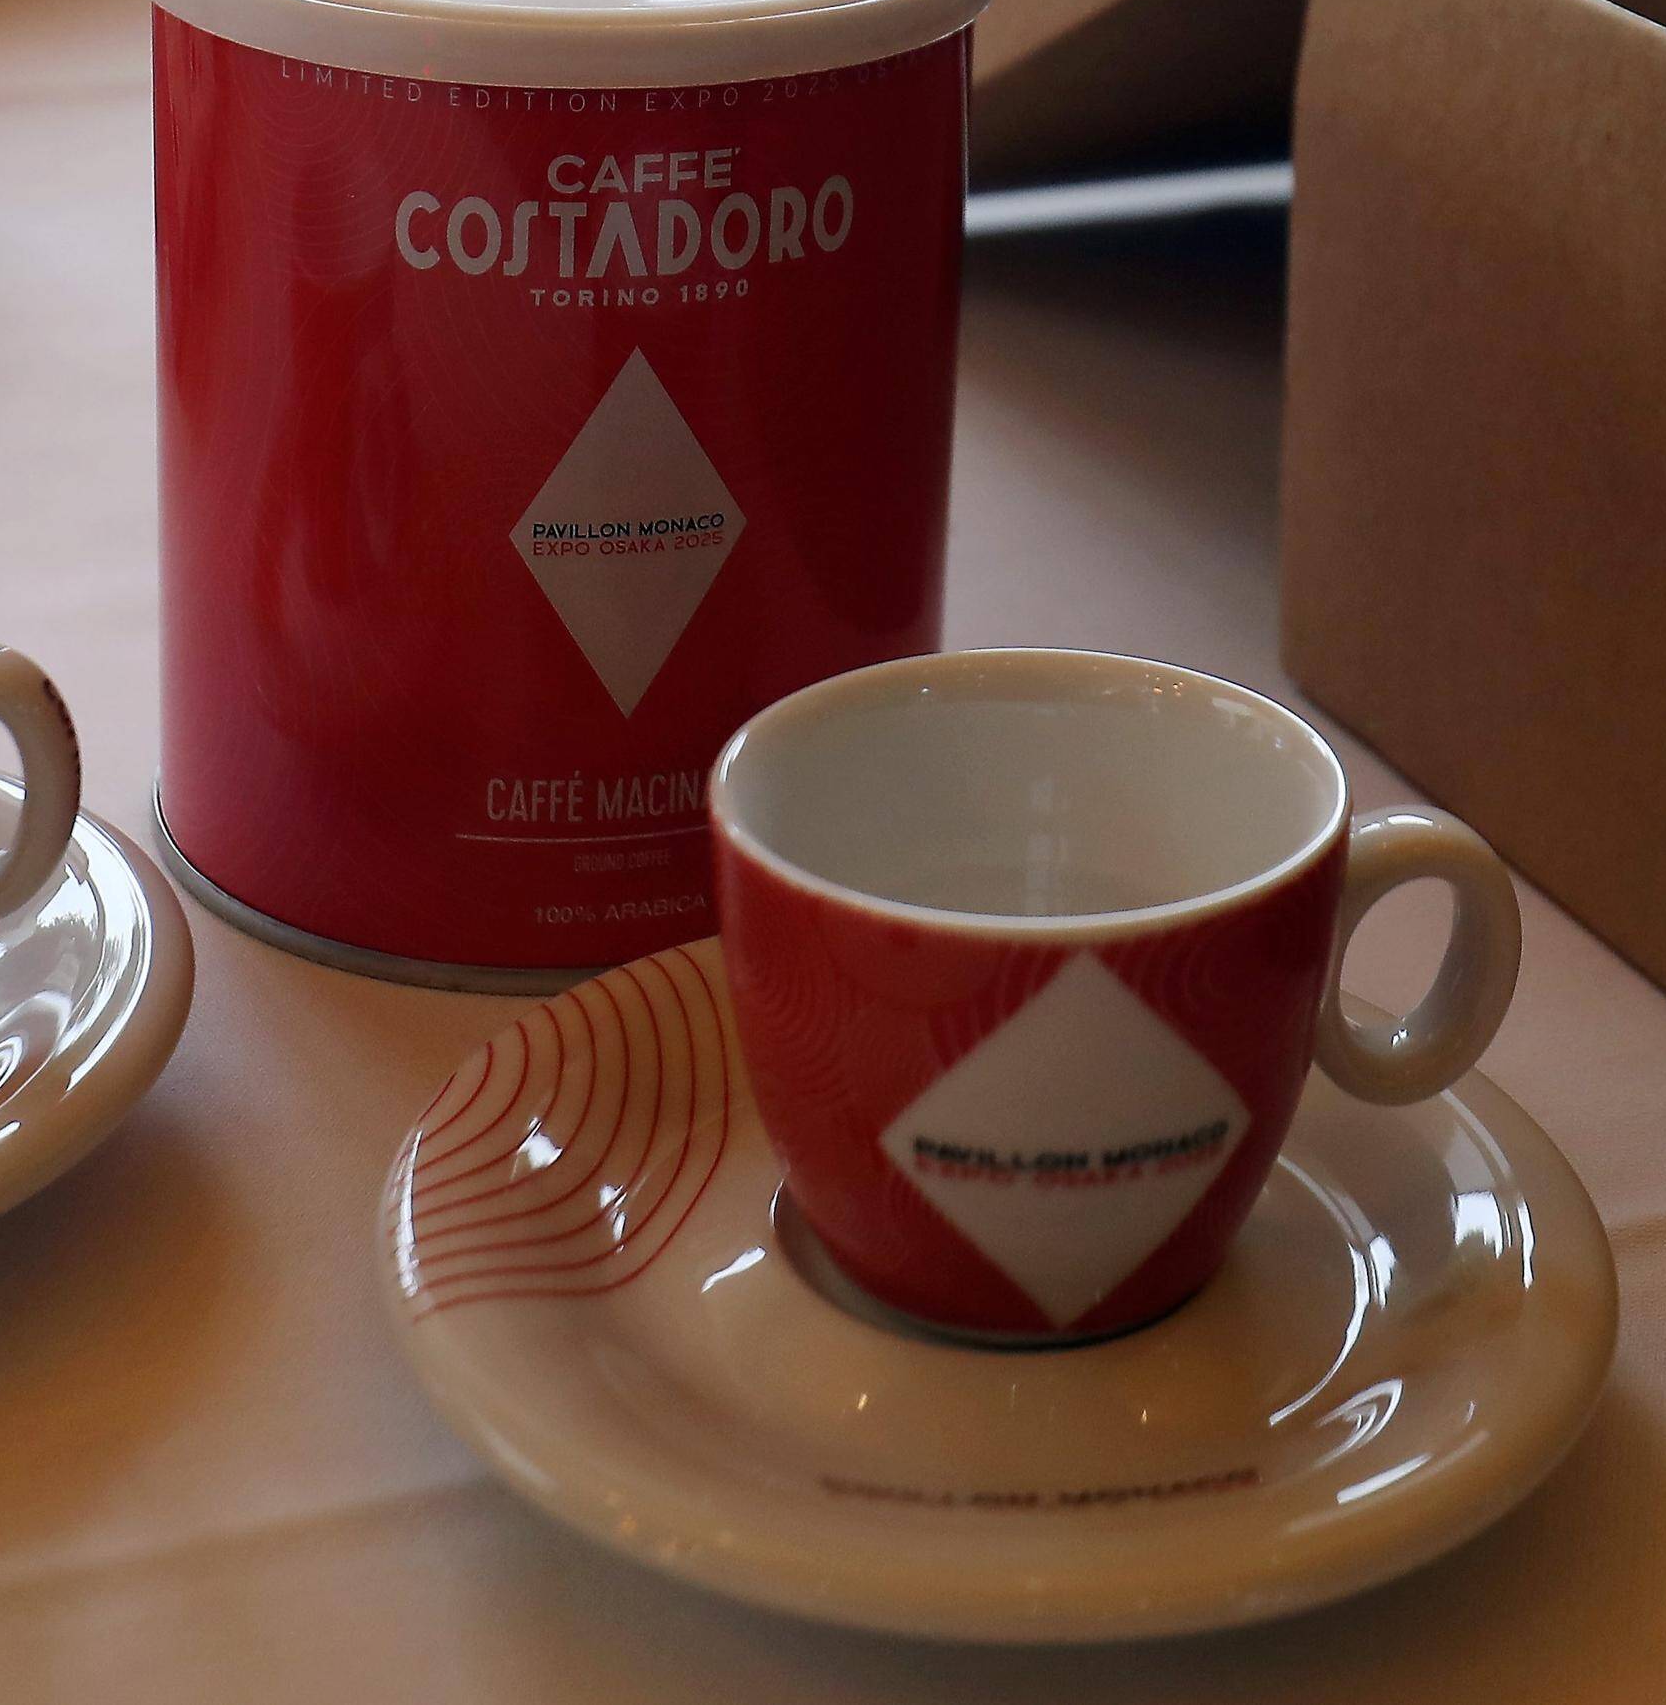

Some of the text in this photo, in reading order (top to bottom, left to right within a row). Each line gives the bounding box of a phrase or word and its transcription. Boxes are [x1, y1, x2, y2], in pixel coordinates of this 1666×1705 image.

[281, 58, 423, 102] LIMITED
[450, 86, 617, 113] EDITION
[645, 85, 739, 112] EXPO
[395, 174, 855, 279] COSTADORO
[530, 278, 749, 307] TORINO 1890
[532, 513, 725, 539] PAVILLON MONACO
[532, 531, 724, 557] EXPO OSAKA 2025
[487, 769, 584, 823] CAFFÉ
[534, 895, 707, 925] 100% ARABICA
